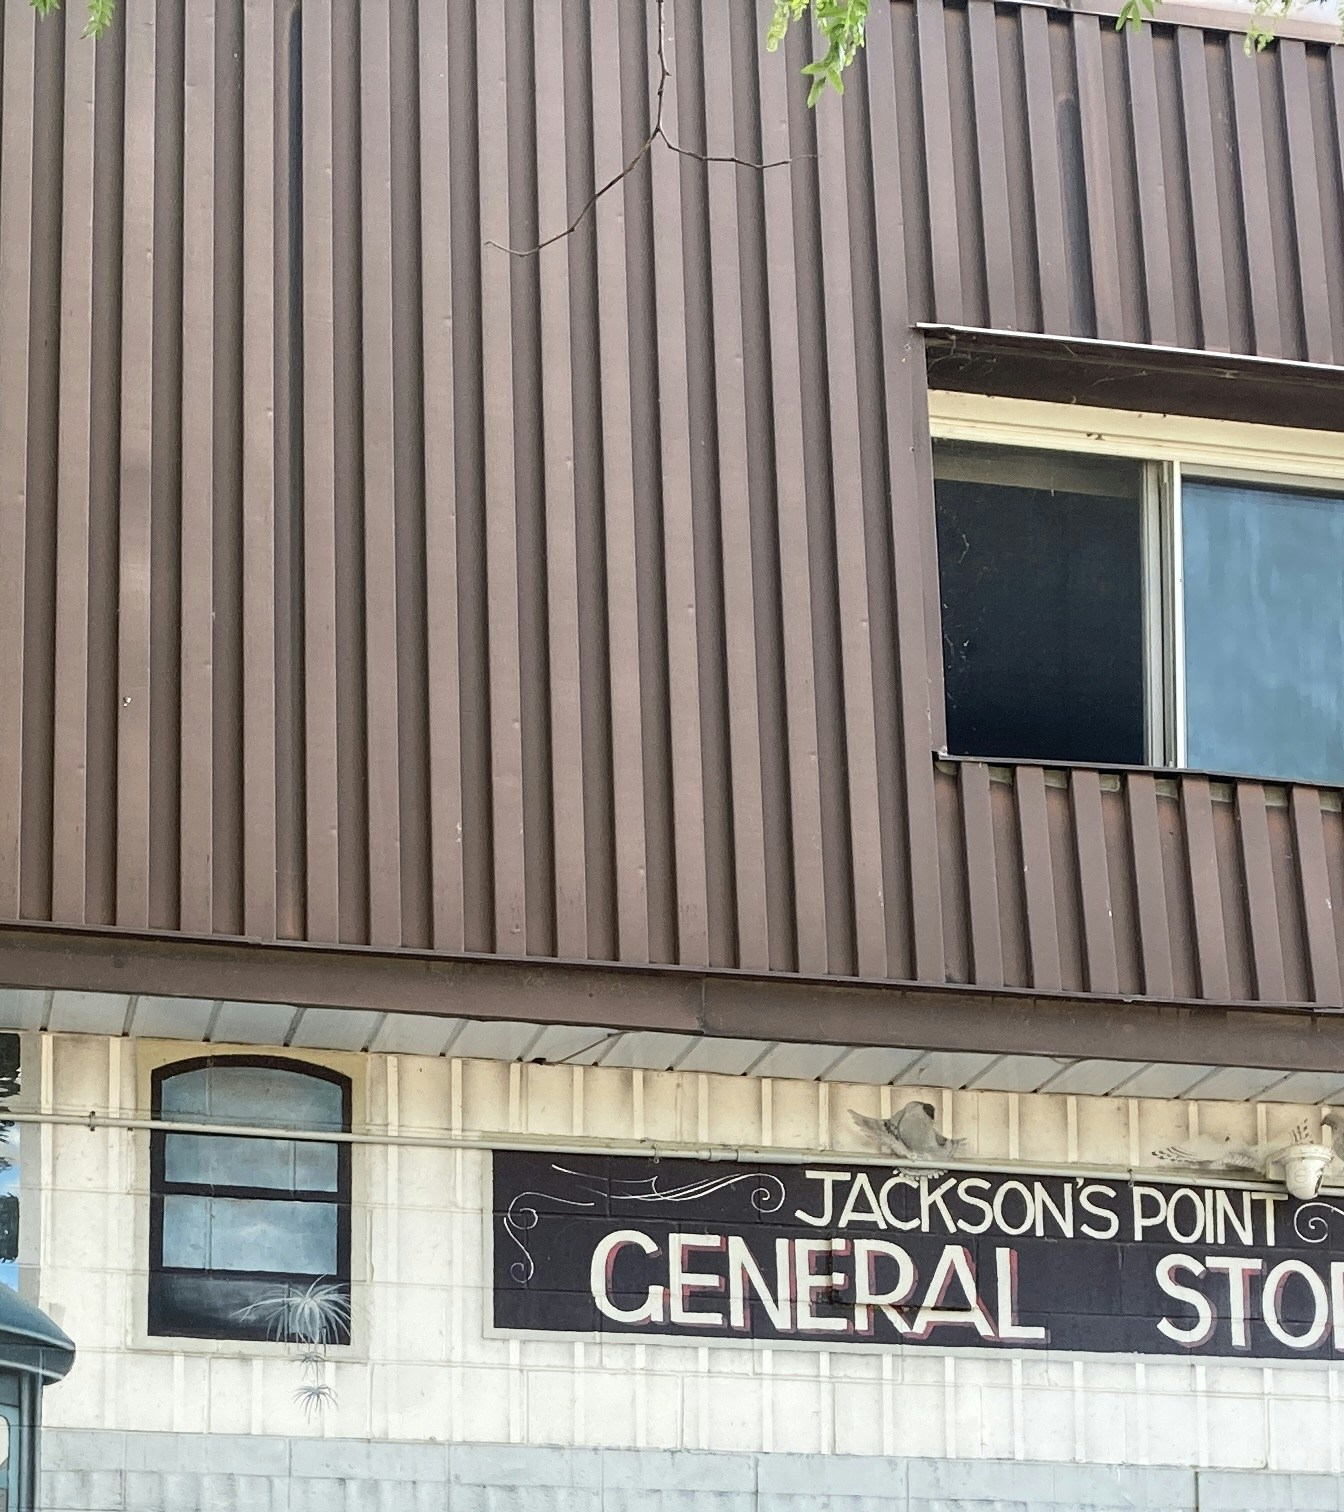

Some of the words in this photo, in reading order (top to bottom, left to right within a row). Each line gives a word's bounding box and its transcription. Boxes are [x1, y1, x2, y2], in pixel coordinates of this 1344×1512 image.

[795, 1169, 1119, 1240] JACKSON'S
[1134, 1185, 1289, 1246] POINT
[590, 1229, 1049, 1341] GENERAL
